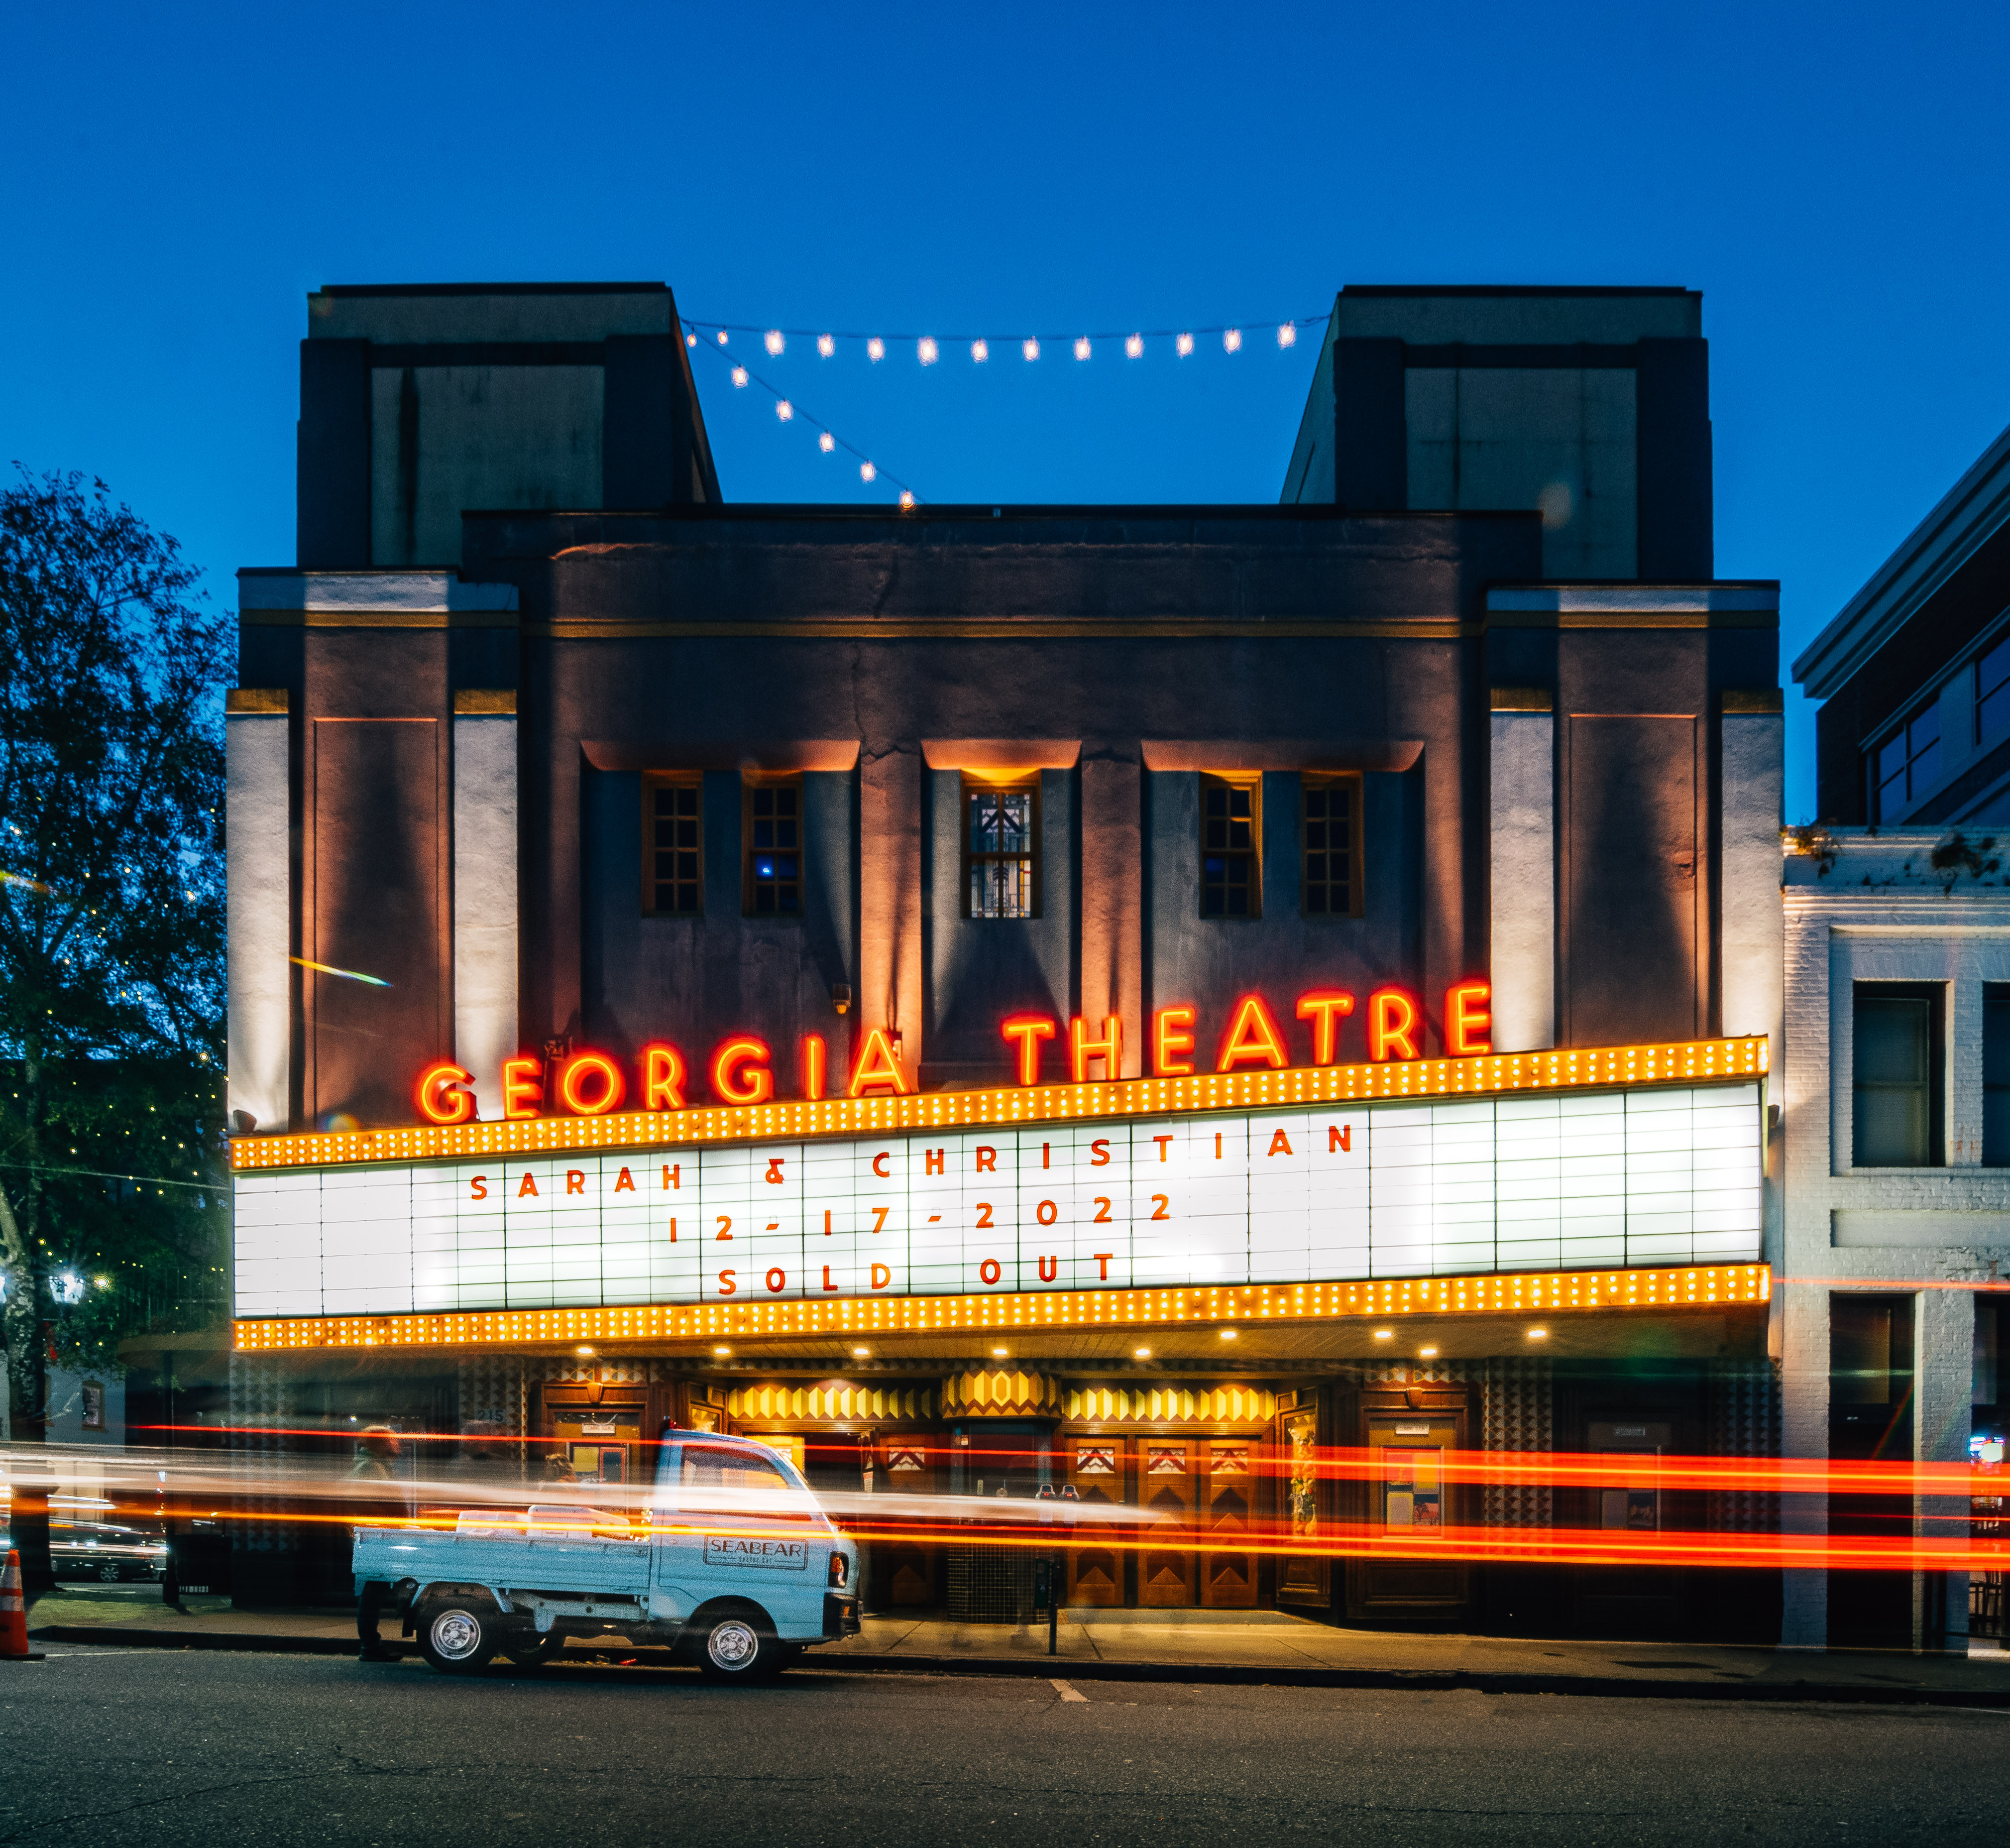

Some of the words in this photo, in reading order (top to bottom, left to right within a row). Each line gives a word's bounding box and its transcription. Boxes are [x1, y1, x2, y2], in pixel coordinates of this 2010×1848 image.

[417, 1027, 910, 1124] GEORGIA
[1002, 983, 1492, 1085] THEATRE
[470, 1164, 680, 1200] SARAH
[765, 1158, 784, 1184] &
[872, 1124, 1351, 1178] CHRISTIAN
[718, 1263, 892, 1295] SOLD
[980, 1253, 1114, 1285] OUT
[710, 1539, 802, 1557] SEABEAR
